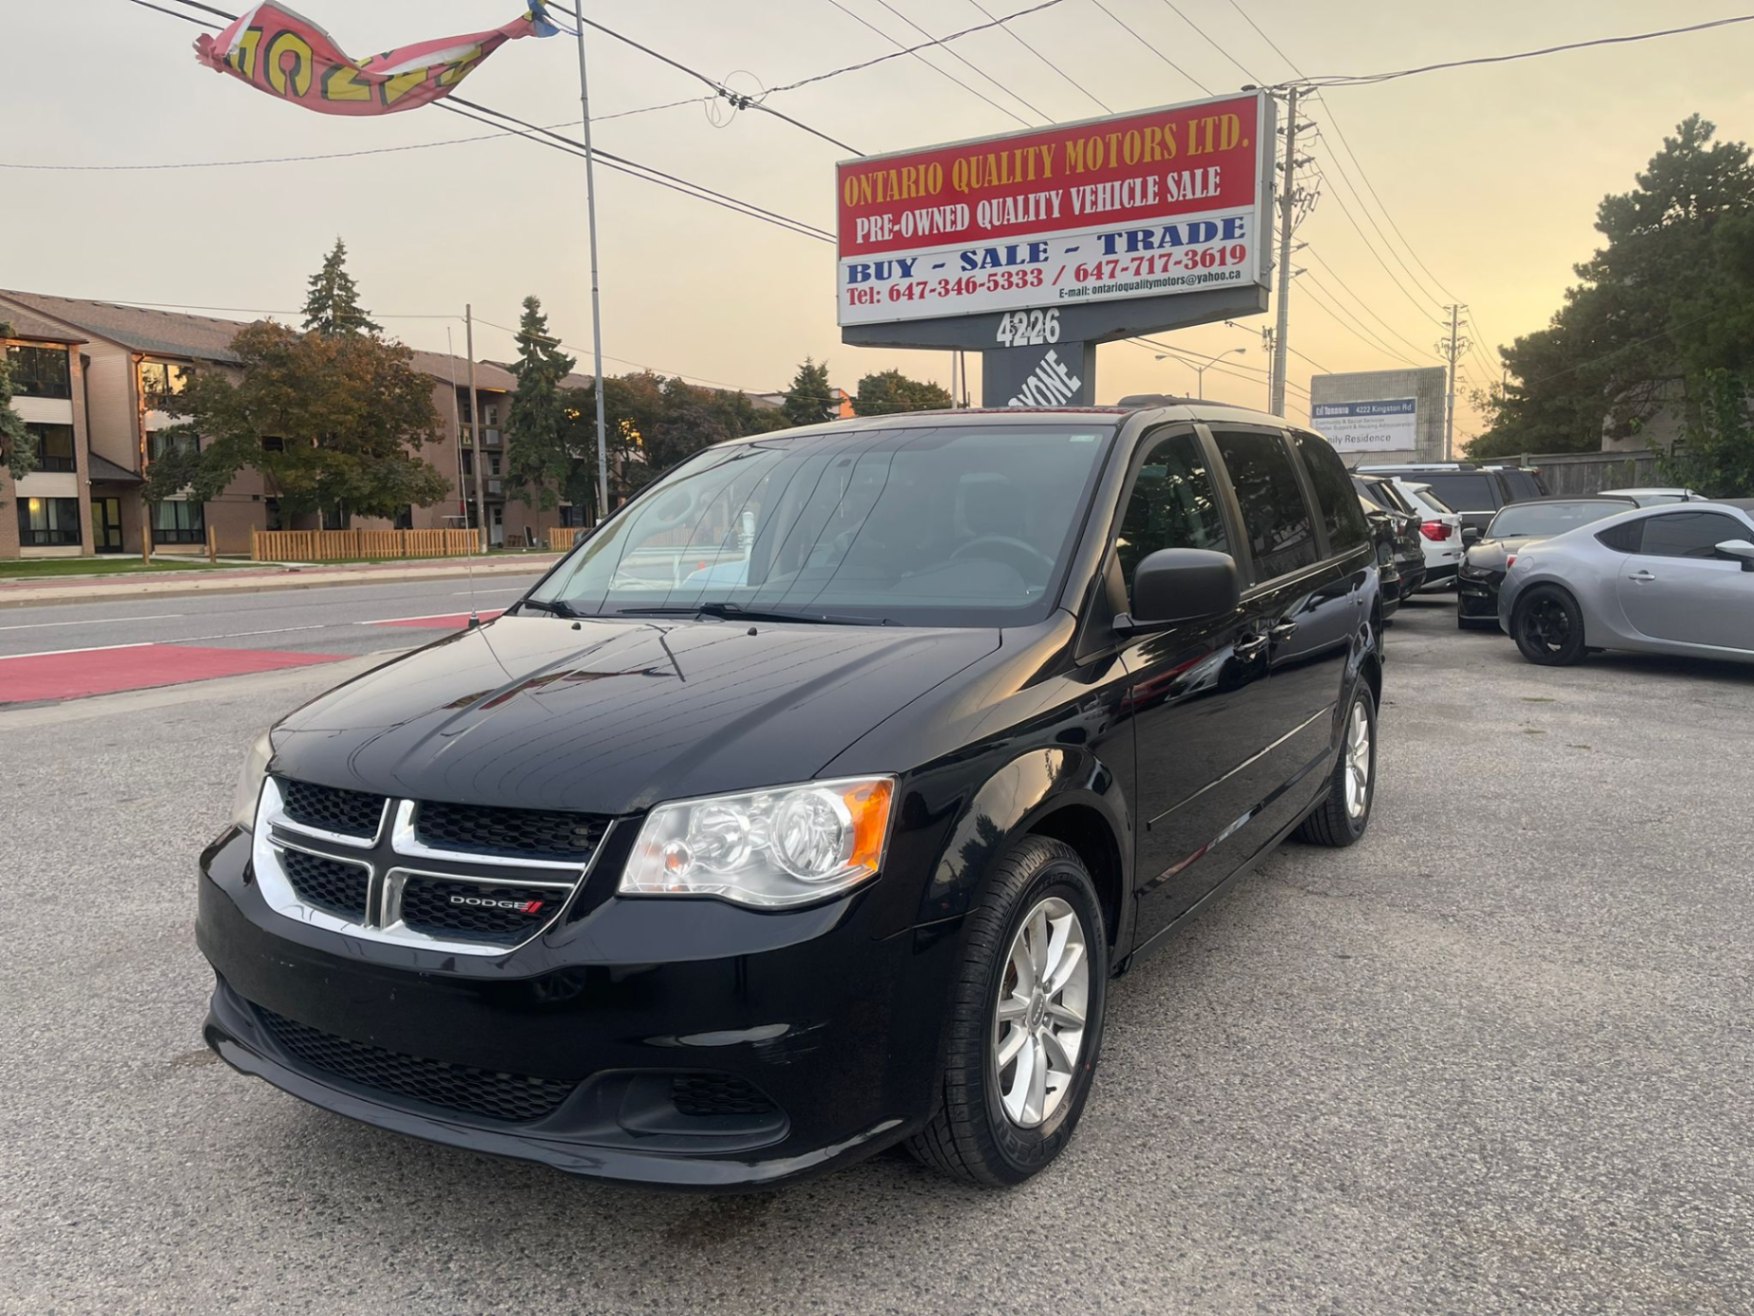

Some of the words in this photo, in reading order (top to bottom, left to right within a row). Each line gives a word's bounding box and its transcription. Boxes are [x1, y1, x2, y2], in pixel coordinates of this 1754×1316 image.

[844, 161, 944, 208] ONTARIO
[952, 143, 1056, 194] QUALITY
[1065, 122, 1177, 175] MOTORS
[1187, 113, 1249, 156] LTD.
[855, 203, 971, 244] PRE-OWNED
[976, 189, 1063, 230] QUALITY
[1070, 175, 1160, 216] VEHICLE
[1167, 166, 1221, 202] SALE
[847, 257, 918, 285] BUY
[959, 241, 1050, 272] SALE
[1097, 216, 1247, 256] TRADE
[847, 286, 882, 306] Tel:
[888, 267, 1044, 302] 647-346-5333
[1074, 243, 1247, 283] 647-717-3619
[1059, 286, 1090, 299] E-mail:
[1091, 269, 1242, 295] ontarioqualitymotors@yahoo.ca
[996, 307, 1060, 348] 4226
[1356, 405, 1371, 414] 4222
[1344, 433, 1392, 443] Residence
[450, 895, 529, 911] DODGE
